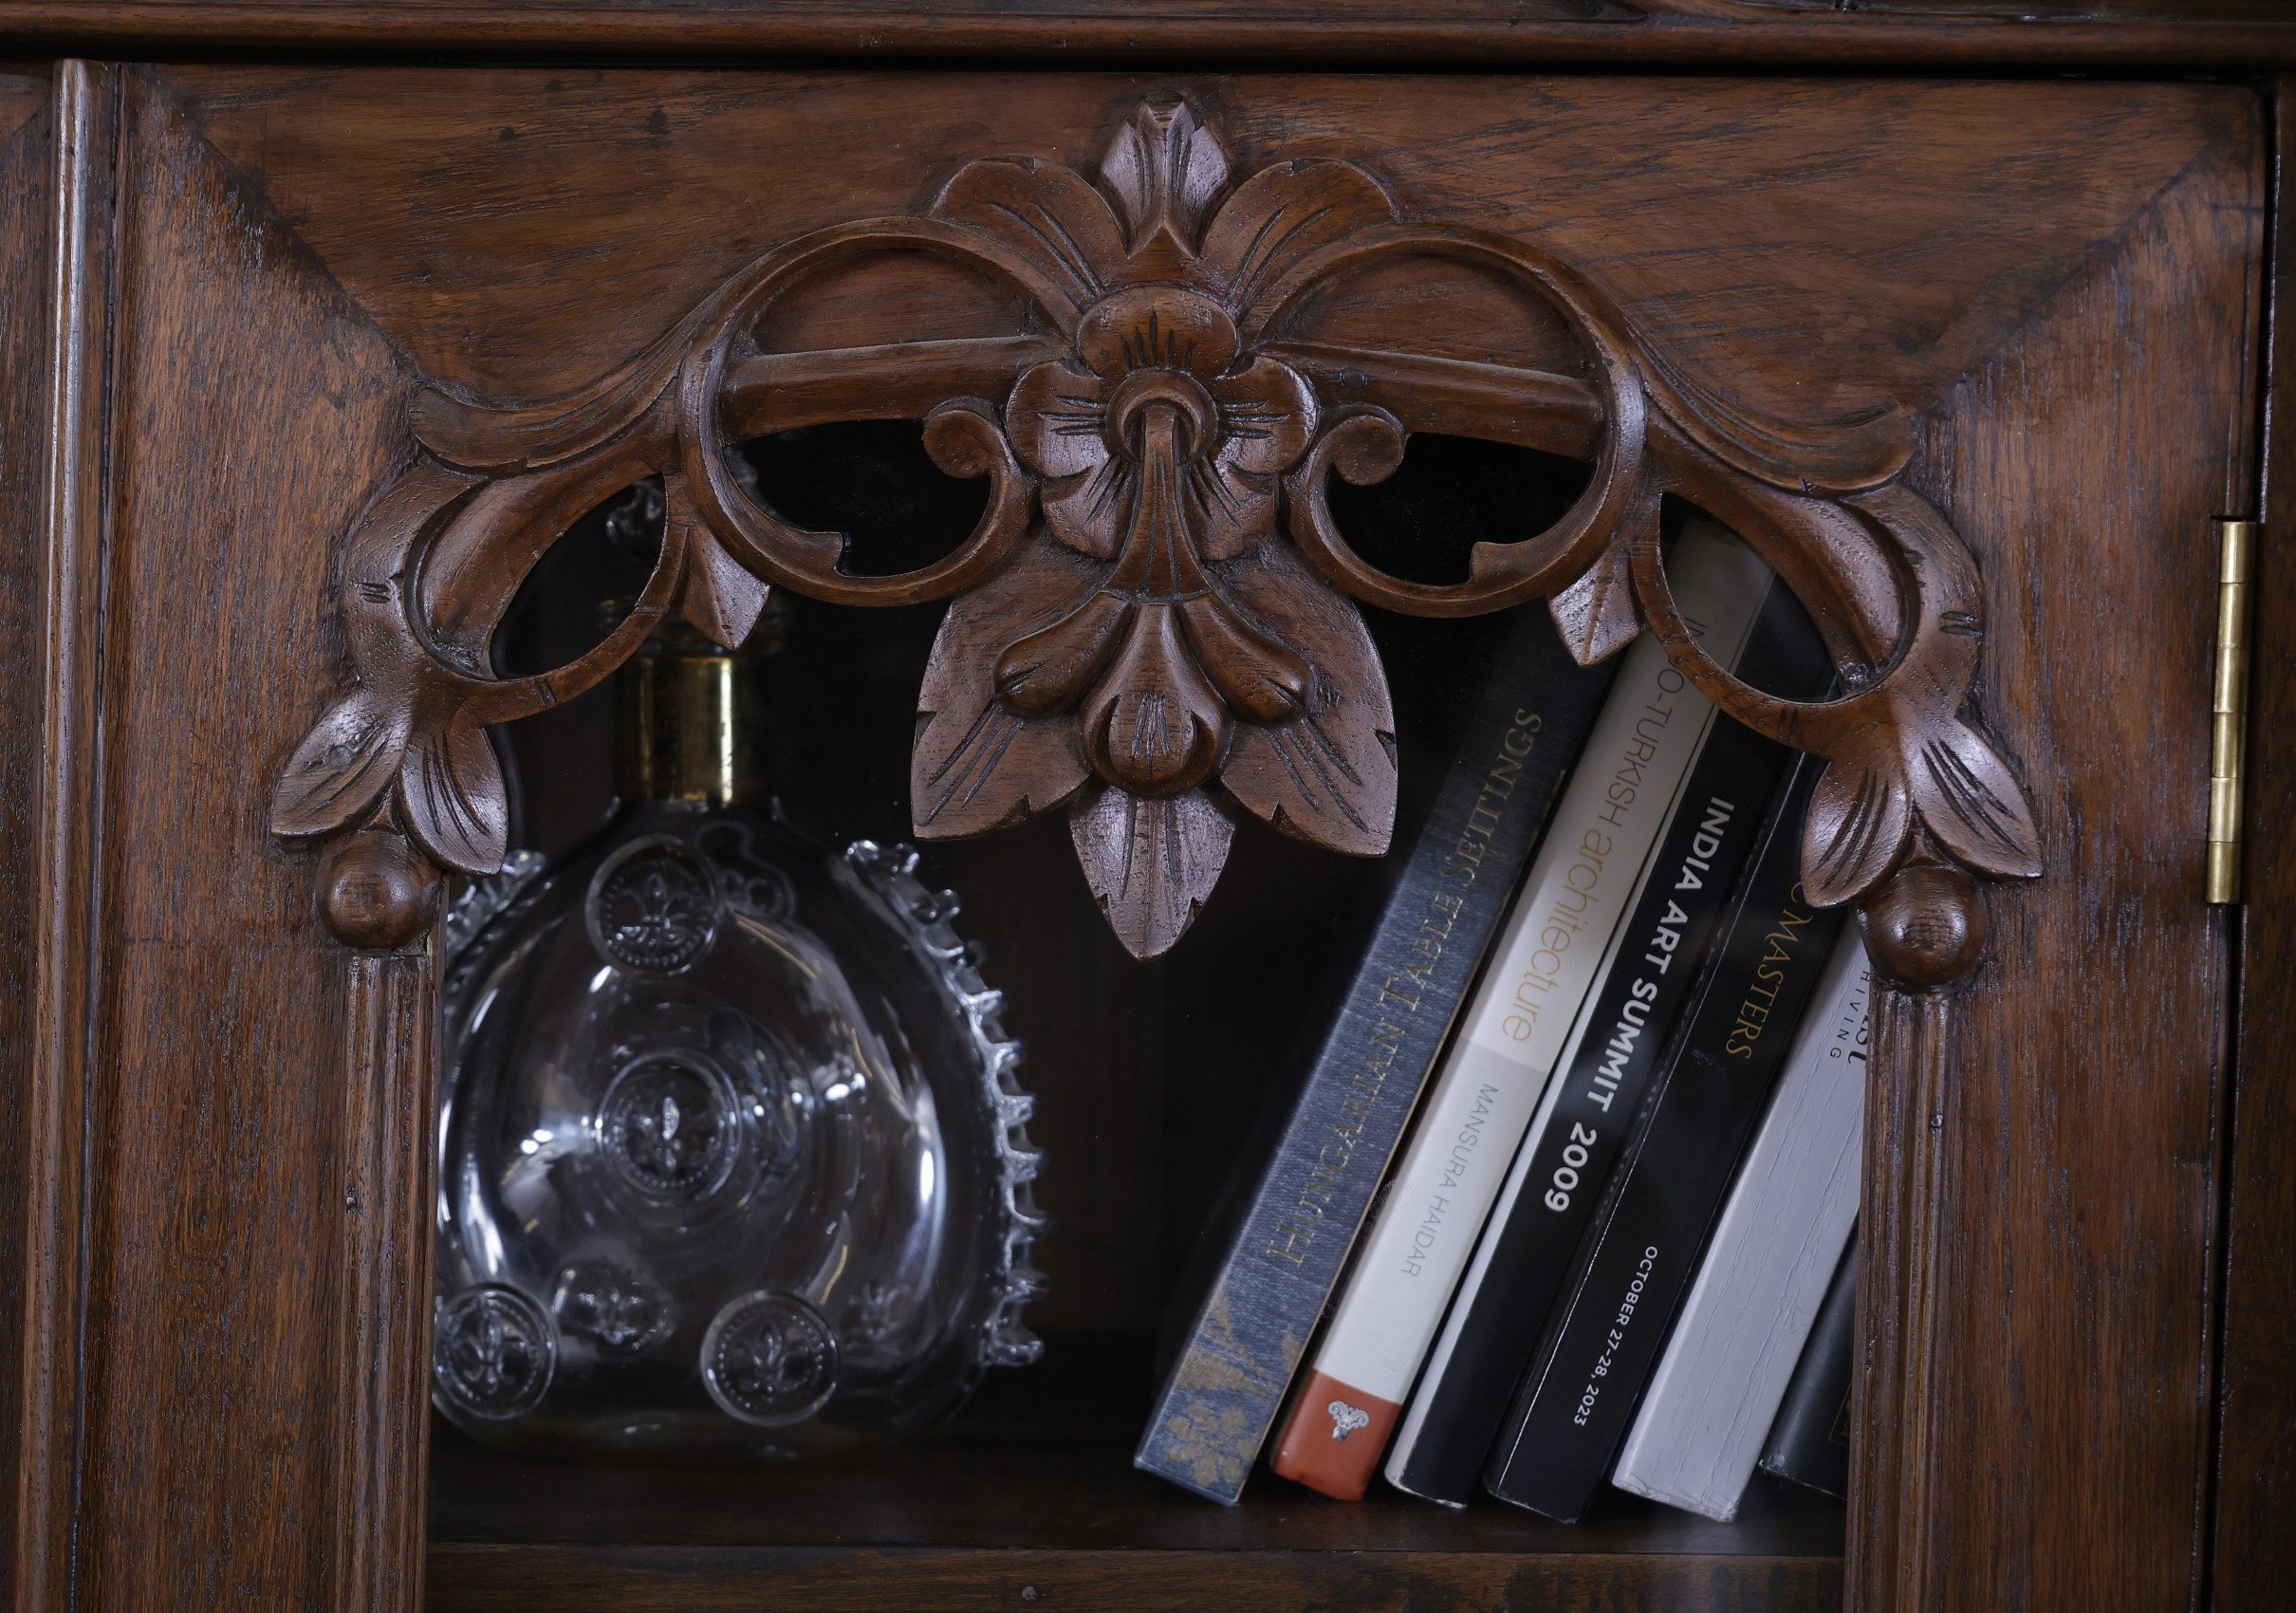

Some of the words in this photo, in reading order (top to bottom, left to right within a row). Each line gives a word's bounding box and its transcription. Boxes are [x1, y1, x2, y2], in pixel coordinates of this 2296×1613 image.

[1599, 617, 1707, 826] IO-TURKISH
[1674, 797, 1734, 890] INDIA
[1502, 828, 1612, 1041] architecture
[1645, 899, 1688, 975] ART
[1267, 1017, 1405, 1267] HUNGARIAN
[1379, 894, 1463, 1011] TABLE
[1441, 708, 1542, 888] SETTINGS
[1725, 907, 1813, 1060] MASTERS
[1830, 971, 1869, 1059] HIVING
[1587, 976, 1657, 1113] SUMMIT
[1439, 1083, 1498, 1188] MANSURA
[1544, 1122, 1597, 1213] 2009
[1401, 1195, 1450, 1276] HAIDAR
[1616, 1246, 1658, 1326] OCTOBER
[1590, 1327, 1622, 1379] 27-28,
[1574, 1384, 1599, 1426] 2023
